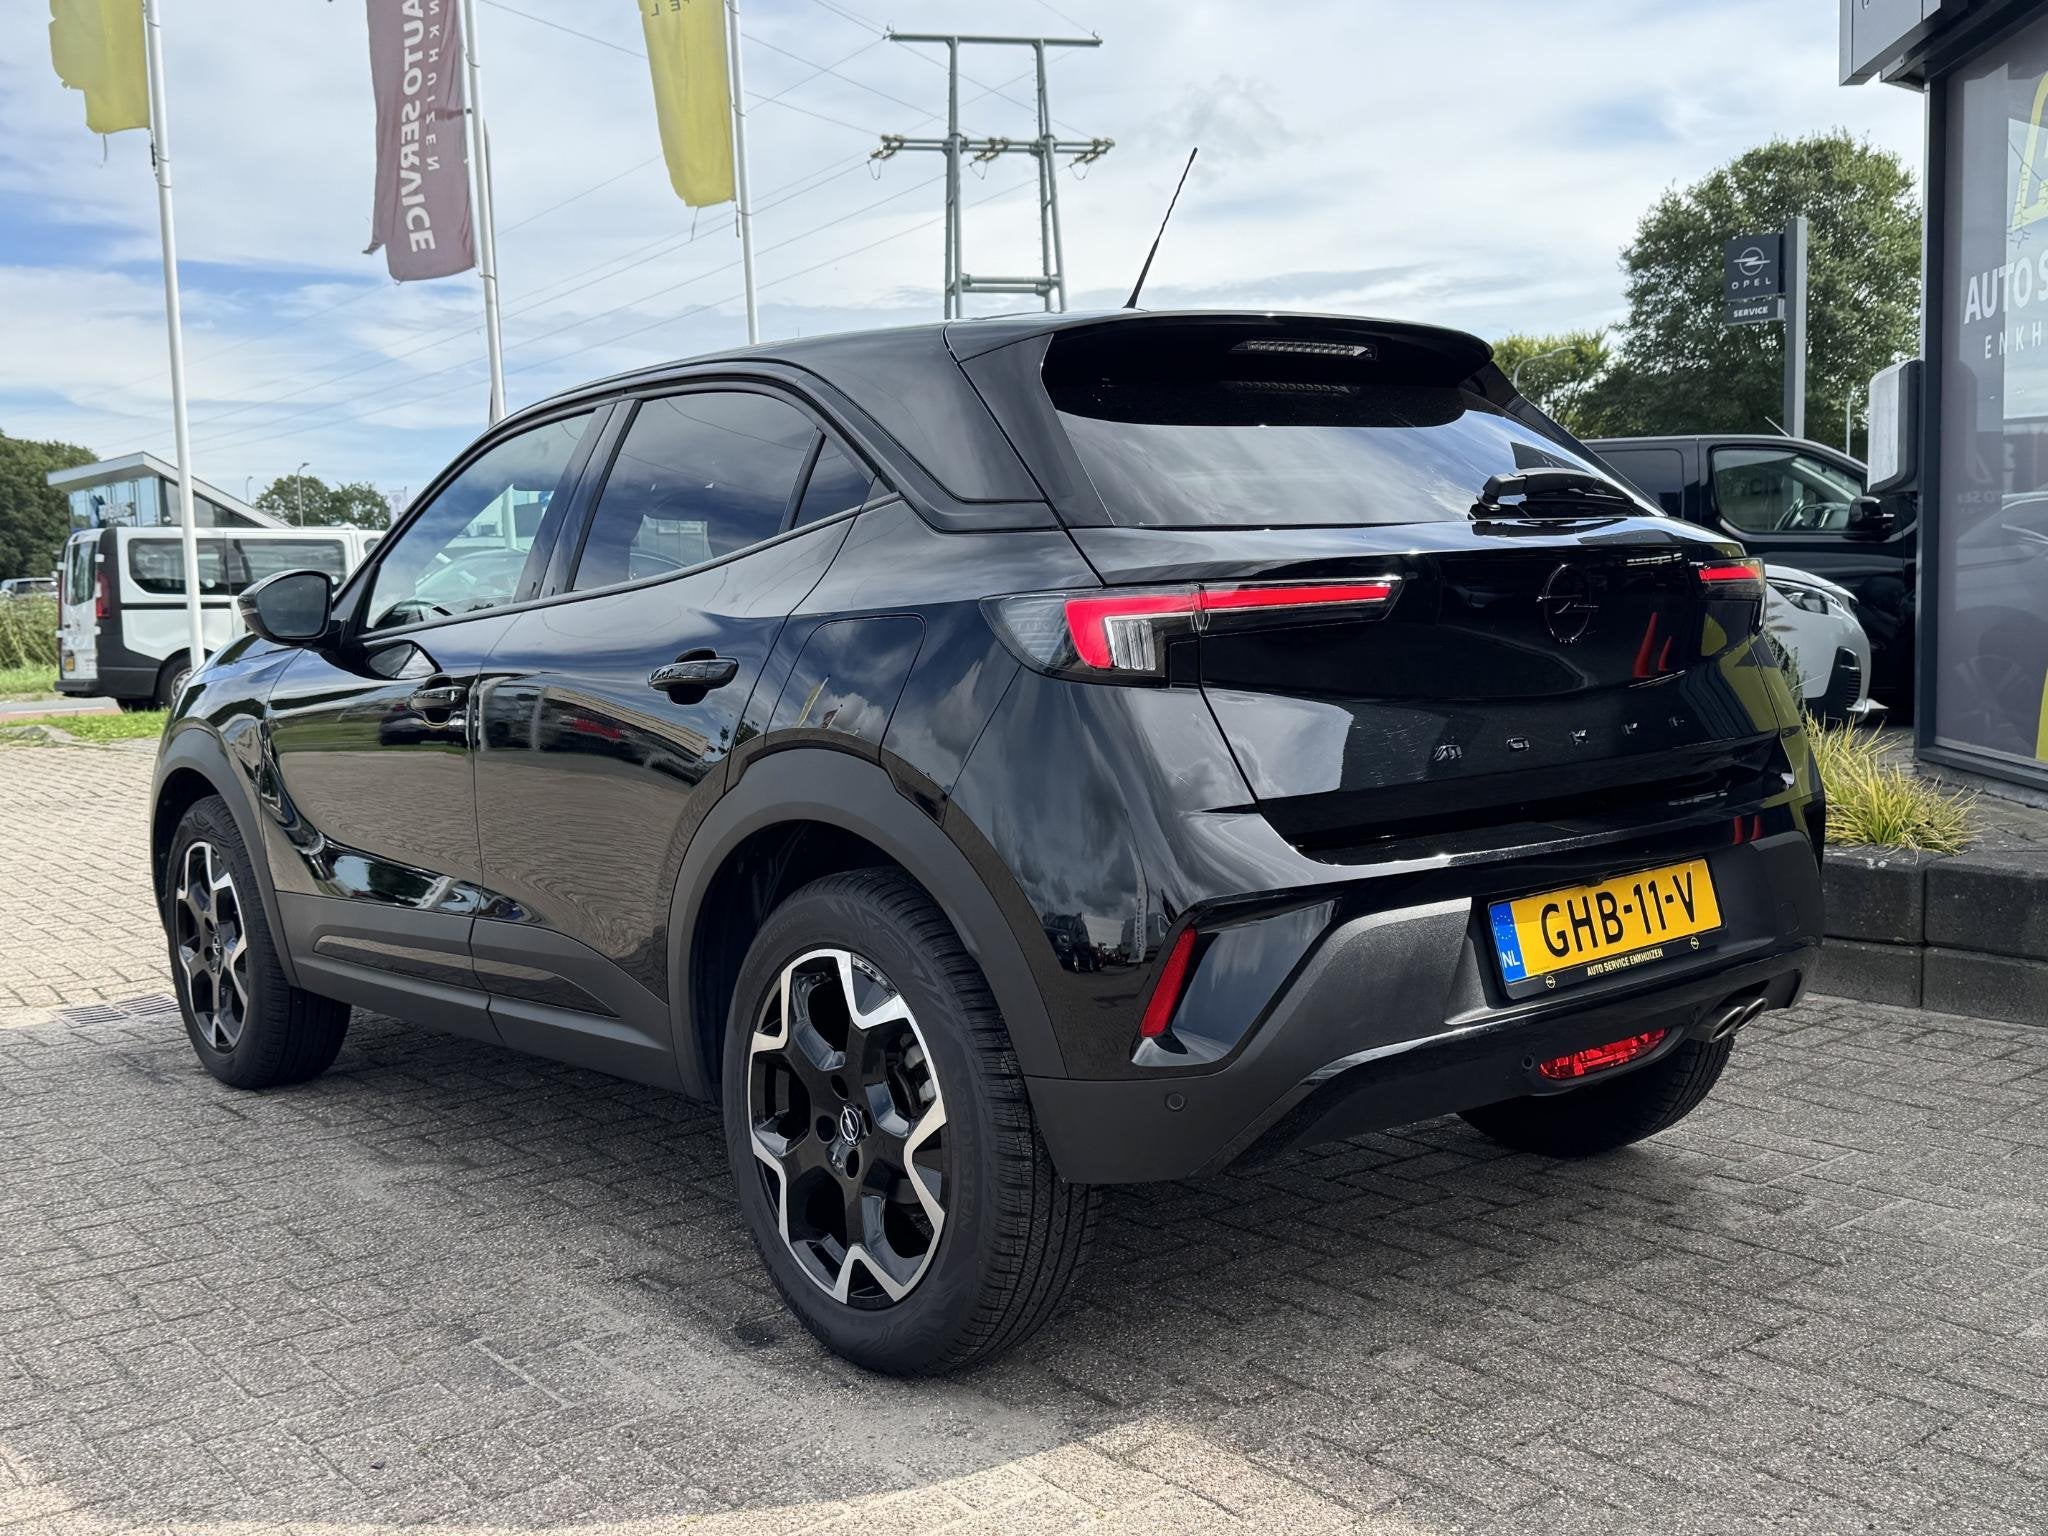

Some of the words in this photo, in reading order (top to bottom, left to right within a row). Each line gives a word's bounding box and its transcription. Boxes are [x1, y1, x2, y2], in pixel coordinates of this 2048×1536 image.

[1731, 277, 1771, 290] OPEL
[1733, 306, 1768, 318] SERVICE
[1541, 871, 1696, 959] GHB-11-V
[1500, 952, 1521, 969] NL
[1587, 965, 1605, 977] AUTO
[1604, 957, 1630, 973] SERVICE
[1629, 948, 1664, 966] ENKHUIZEN
